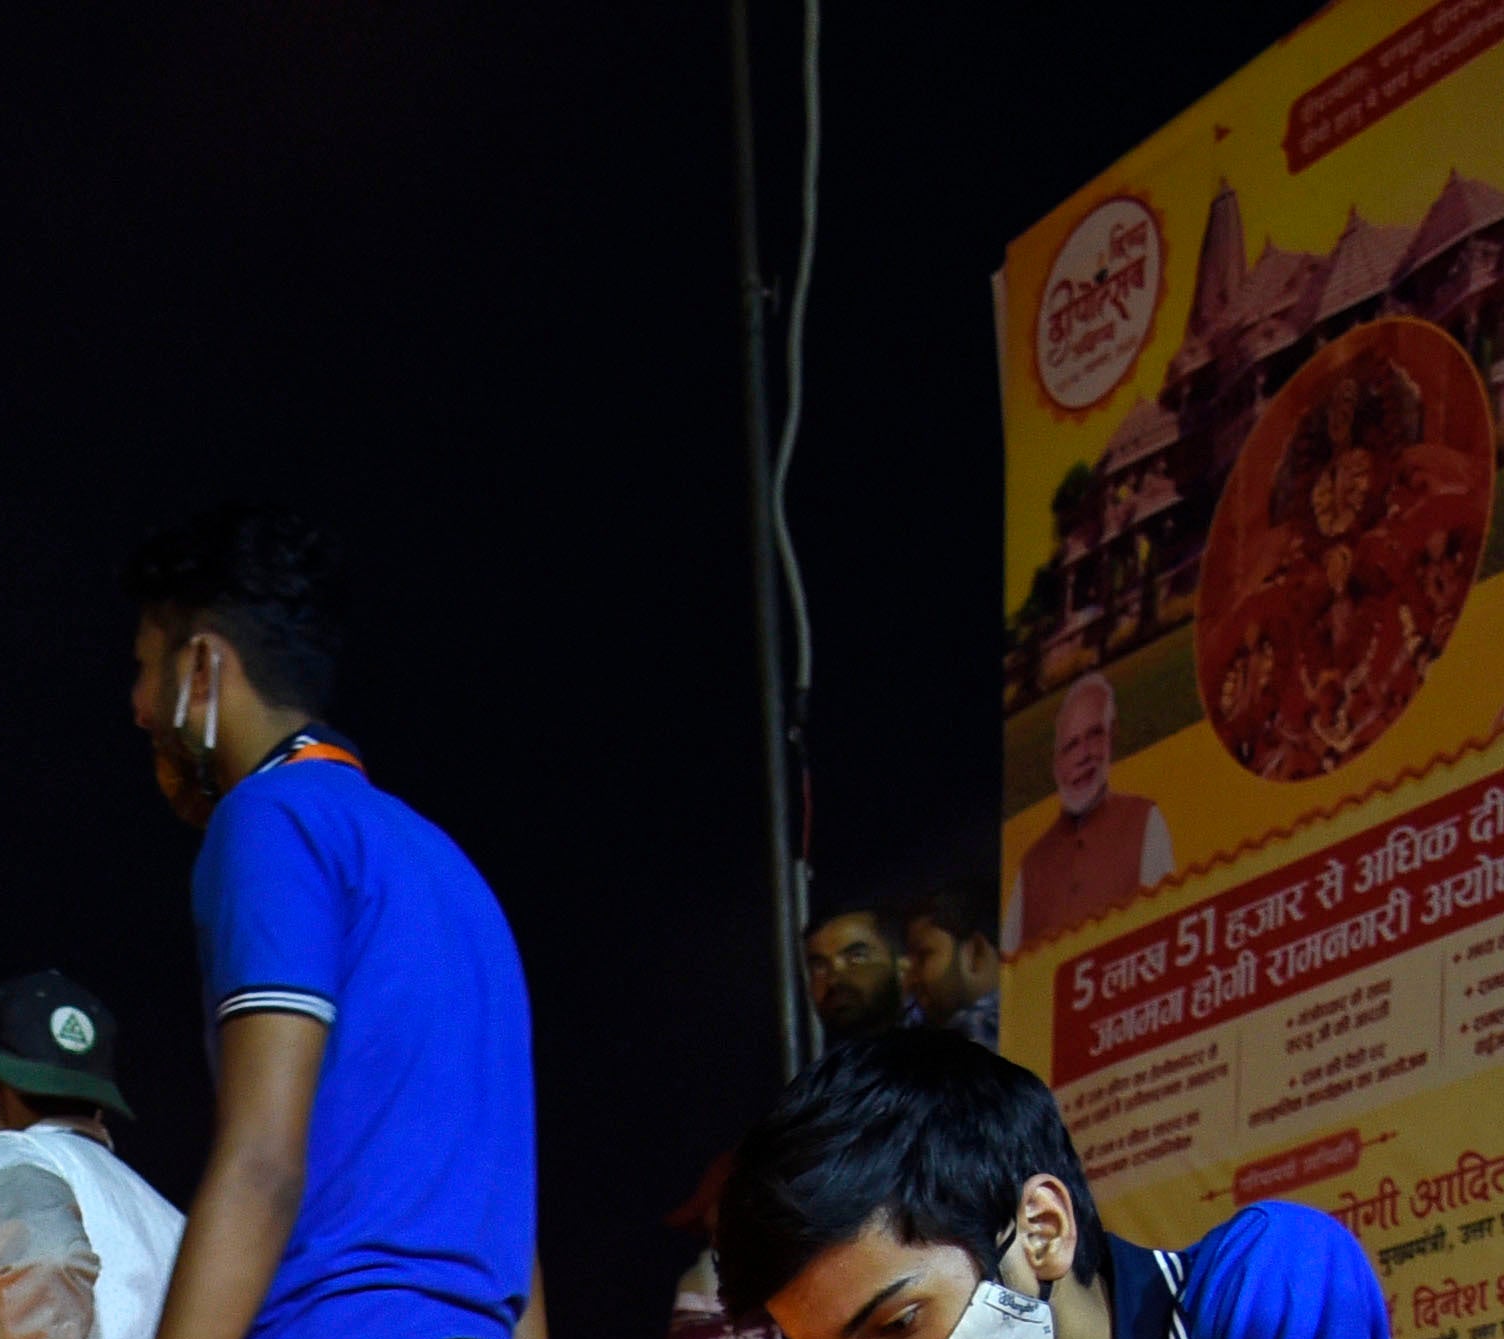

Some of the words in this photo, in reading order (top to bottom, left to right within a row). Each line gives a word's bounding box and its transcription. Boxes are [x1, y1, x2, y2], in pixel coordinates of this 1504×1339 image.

[1071, 958, 1096, 1012] 5
[1100, 937, 1169, 1001] लाख
[1174, 904, 1217, 968] 51
[1224, 880, 1310, 951] हजार
[1315, 856, 1346, 910] से
[1353, 815, 1463, 894] अधिक
[1088, 985, 1186, 1057] जगमग
[1189, 948, 1259, 1019] होगी
[1264, 887, 1412, 987] रामनगरी
[1413, 1277, 1489, 1329] दिनेश
